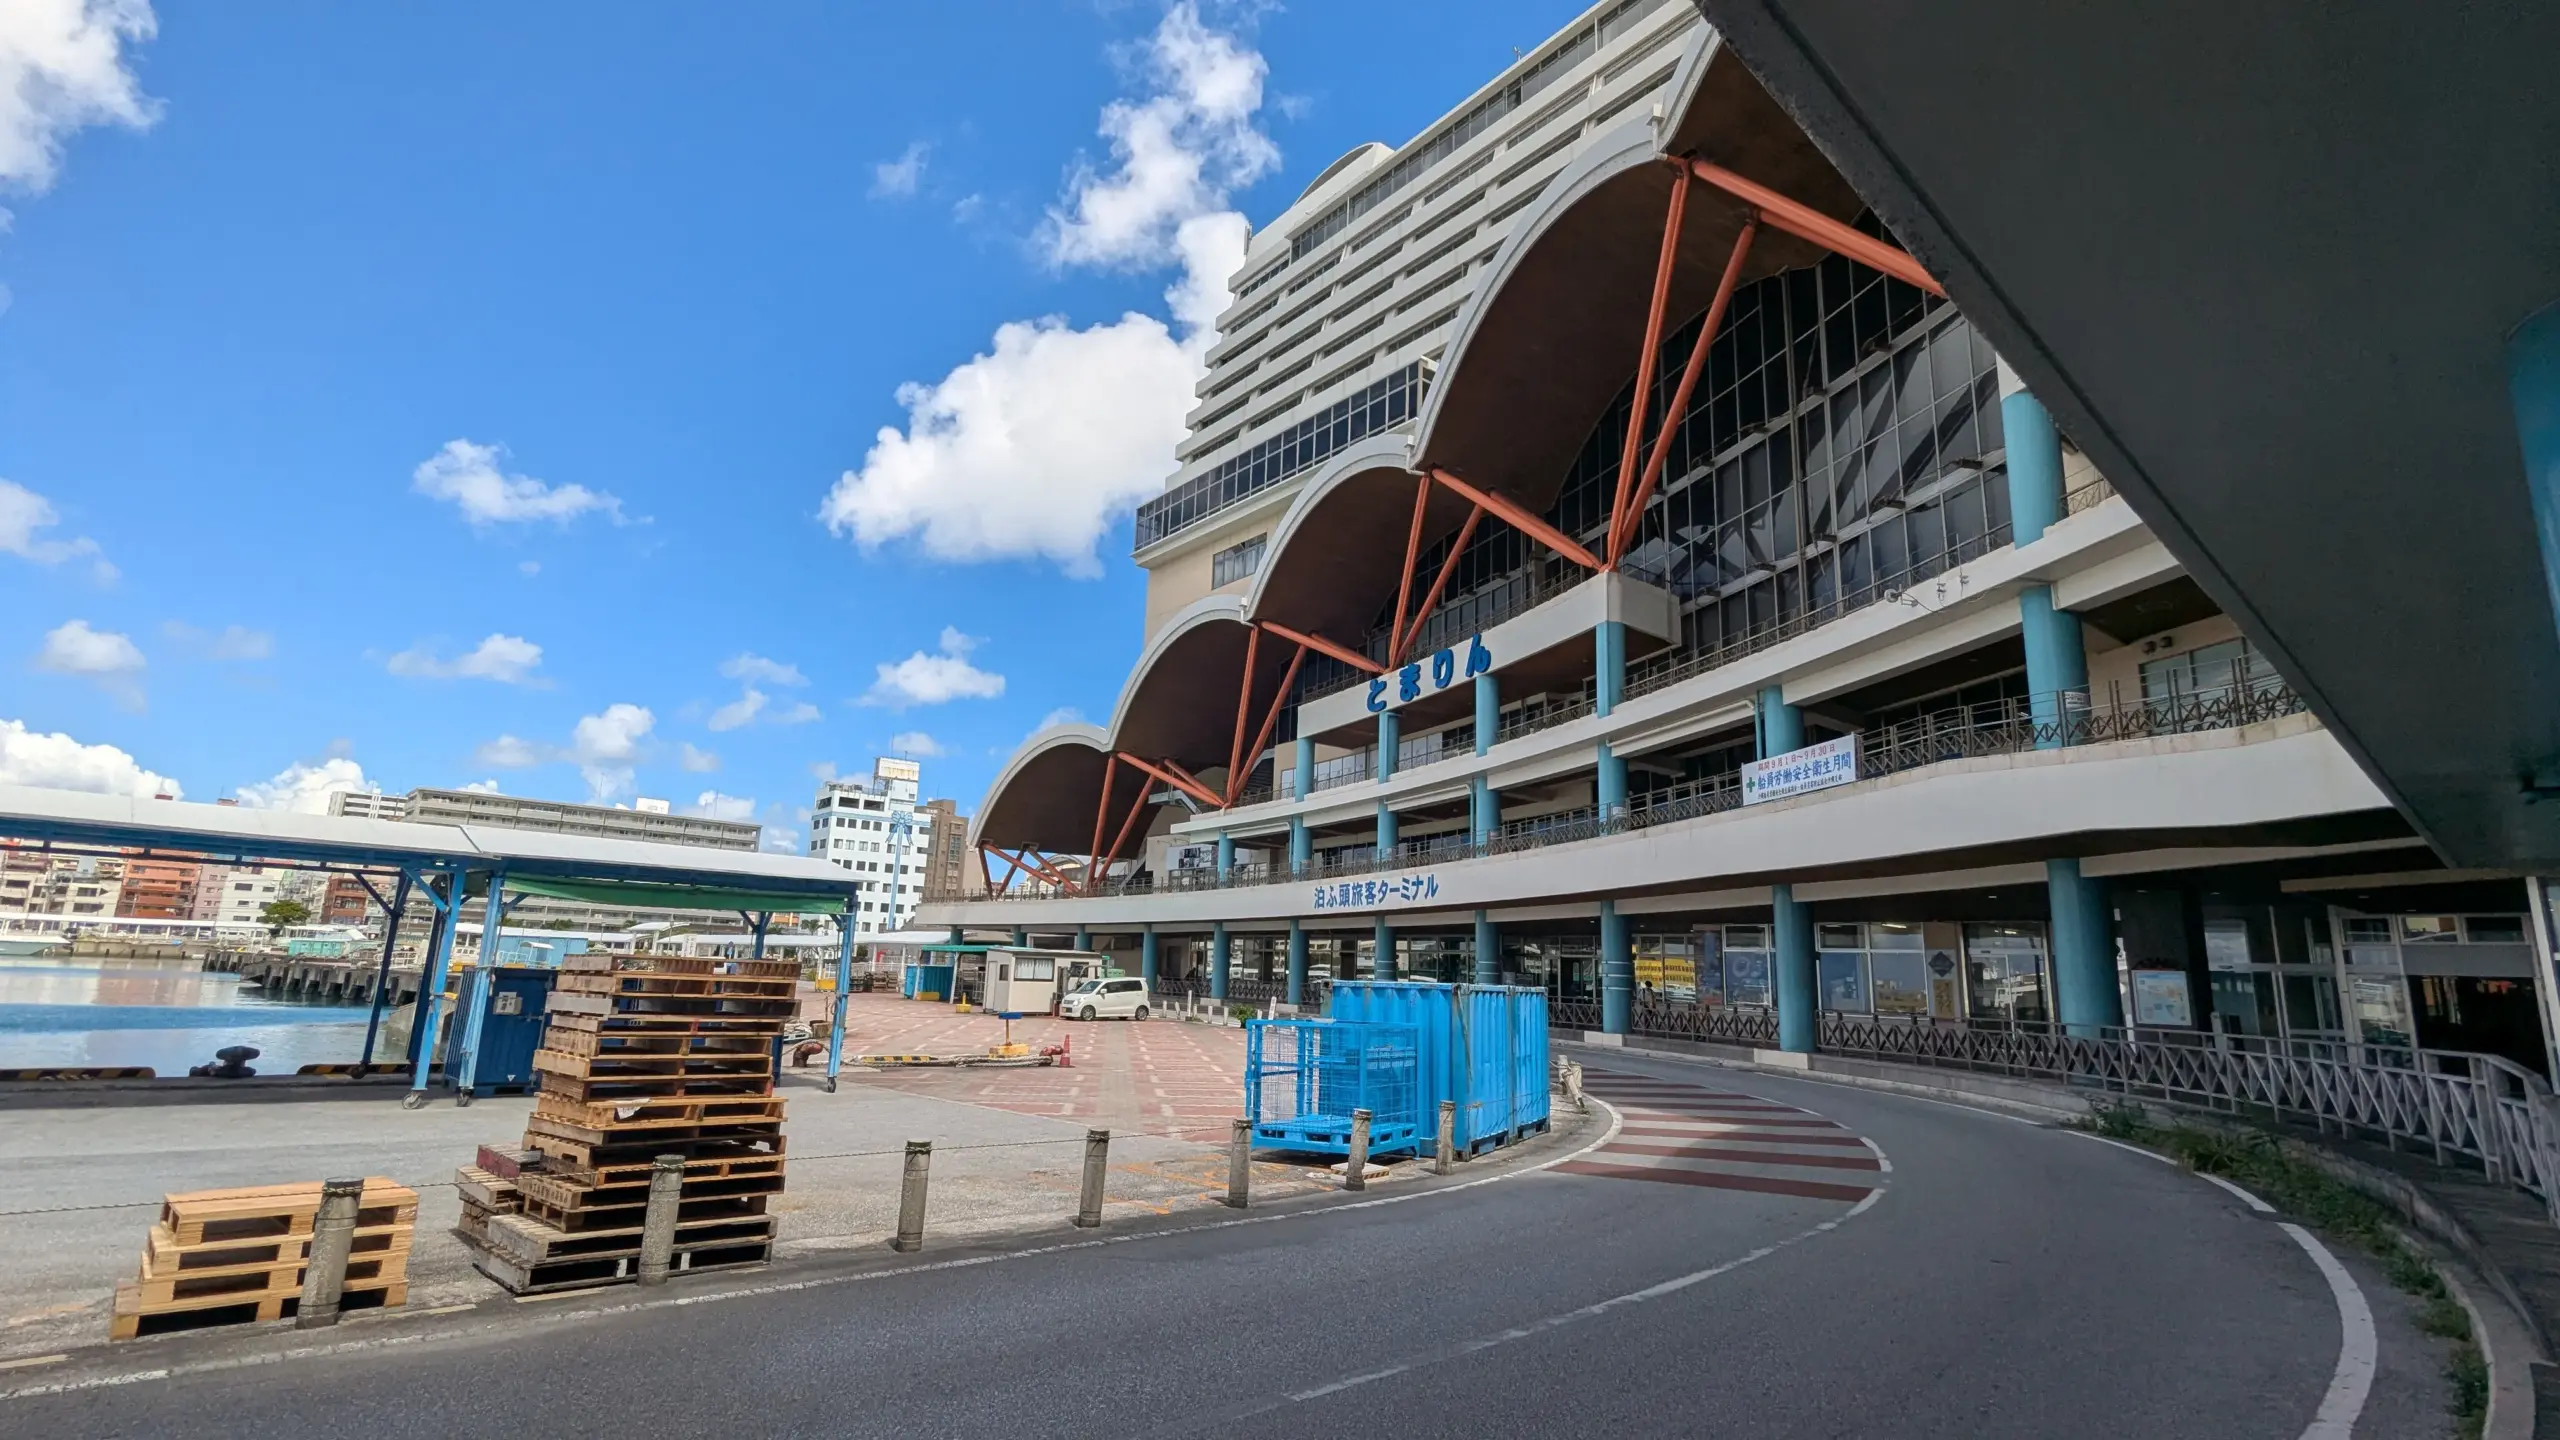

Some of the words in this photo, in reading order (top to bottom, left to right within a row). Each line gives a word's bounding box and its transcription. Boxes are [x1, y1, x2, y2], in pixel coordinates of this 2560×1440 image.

[1367, 633, 1491, 712] とまりん
[1757, 751, 1852, 790] 船員労働安全衛生月間
[1314, 874, 1439, 909] 泊ふ頭旅客ターミナル
